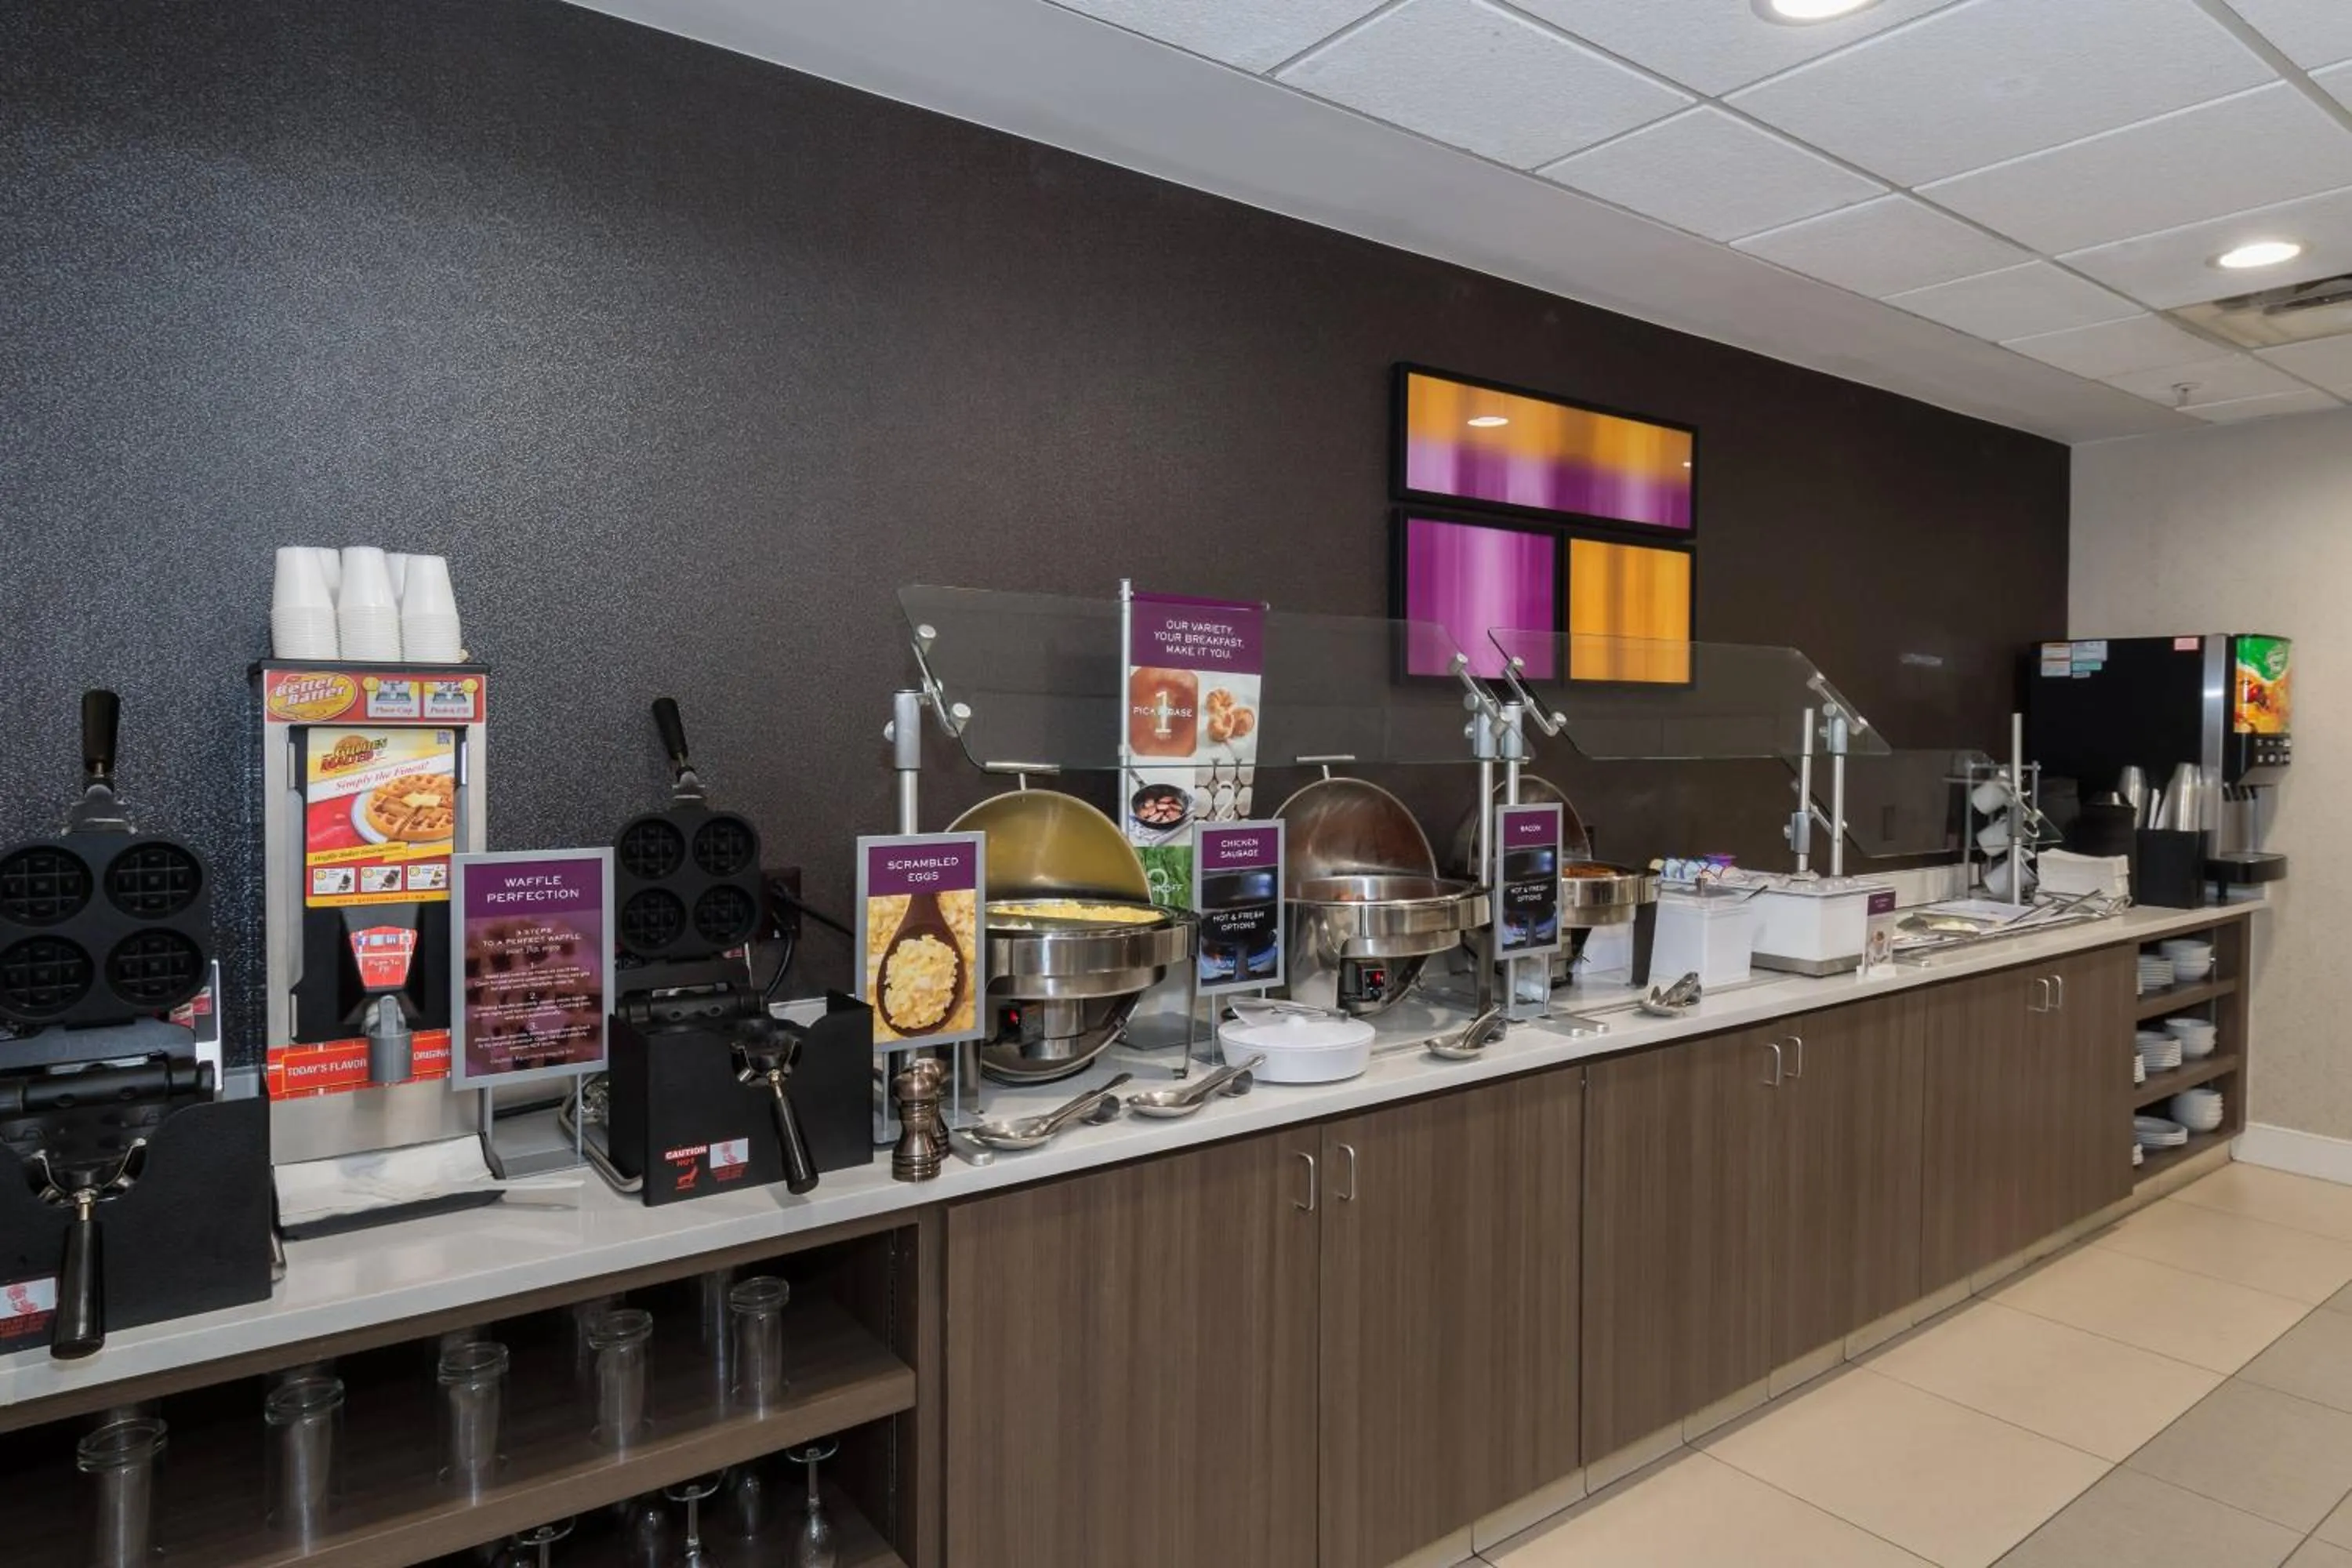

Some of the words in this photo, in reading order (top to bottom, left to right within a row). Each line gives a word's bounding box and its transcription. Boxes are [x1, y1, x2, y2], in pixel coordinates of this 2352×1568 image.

[1166, 620, 1189, 630] OUR
[1154, 631, 1181, 643] YOUR
[1166, 645, 1194, 656] MAKE
[1197, 647, 1207, 657] IT
[1221, 838, 1259, 848] CHICKEN
[1220, 849, 1259, 859] SAUSAGE
[887, 857, 960, 870] SCRAMBLED
[504, 875, 563, 887] WAFFLE
[908, 872, 940, 882] EGGS
[487, 889, 580, 903] PERFECTION
[1213, 913, 1230, 922] HOT
[1231, 913, 1237, 921] &
[1238, 910, 1265, 920] FRESH
[1221, 922, 1257, 931] OPTIONS
[547, 933, 582, 942] WAFFLE
[288, 1062, 327, 1076] TODAY'S
[665, 1145, 708, 1160] CAUTION
